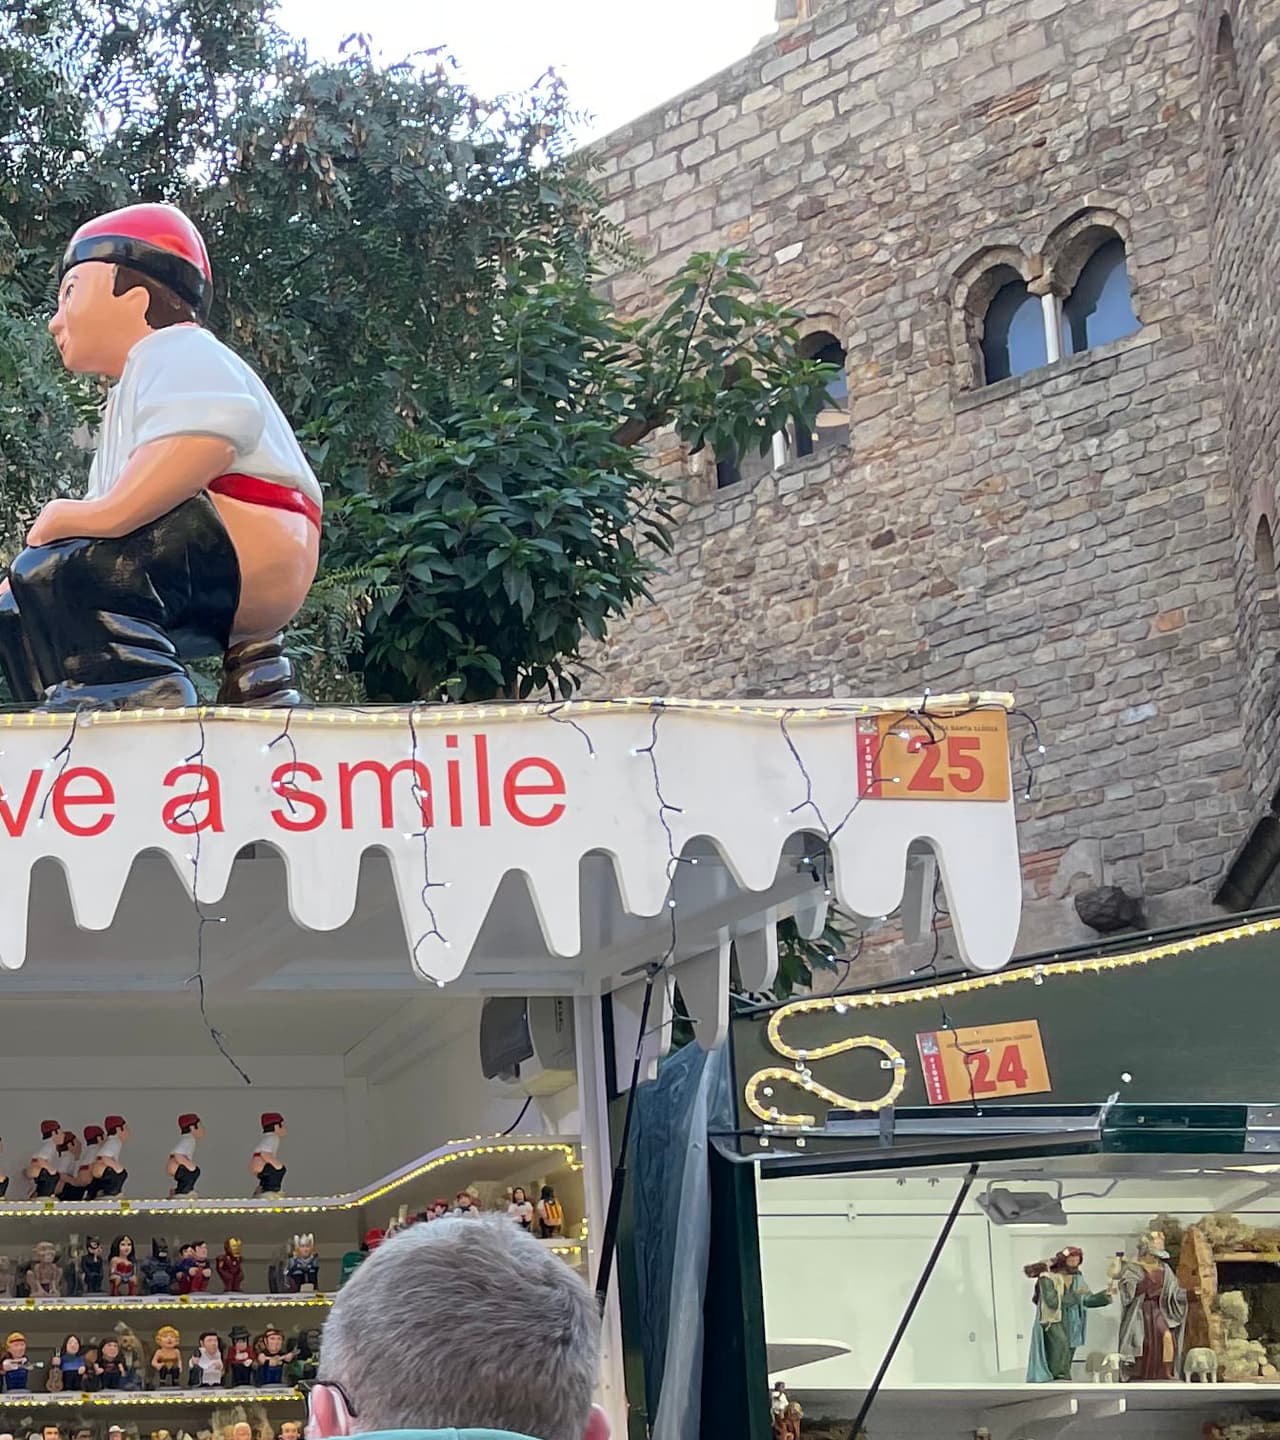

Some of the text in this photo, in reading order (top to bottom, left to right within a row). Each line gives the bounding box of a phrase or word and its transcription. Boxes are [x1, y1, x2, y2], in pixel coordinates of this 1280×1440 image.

[162, 763, 225, 835] a
[270, 733, 567, 832] smile
[906, 734, 985, 793] 25
[963, 1044, 1029, 1094] 24
